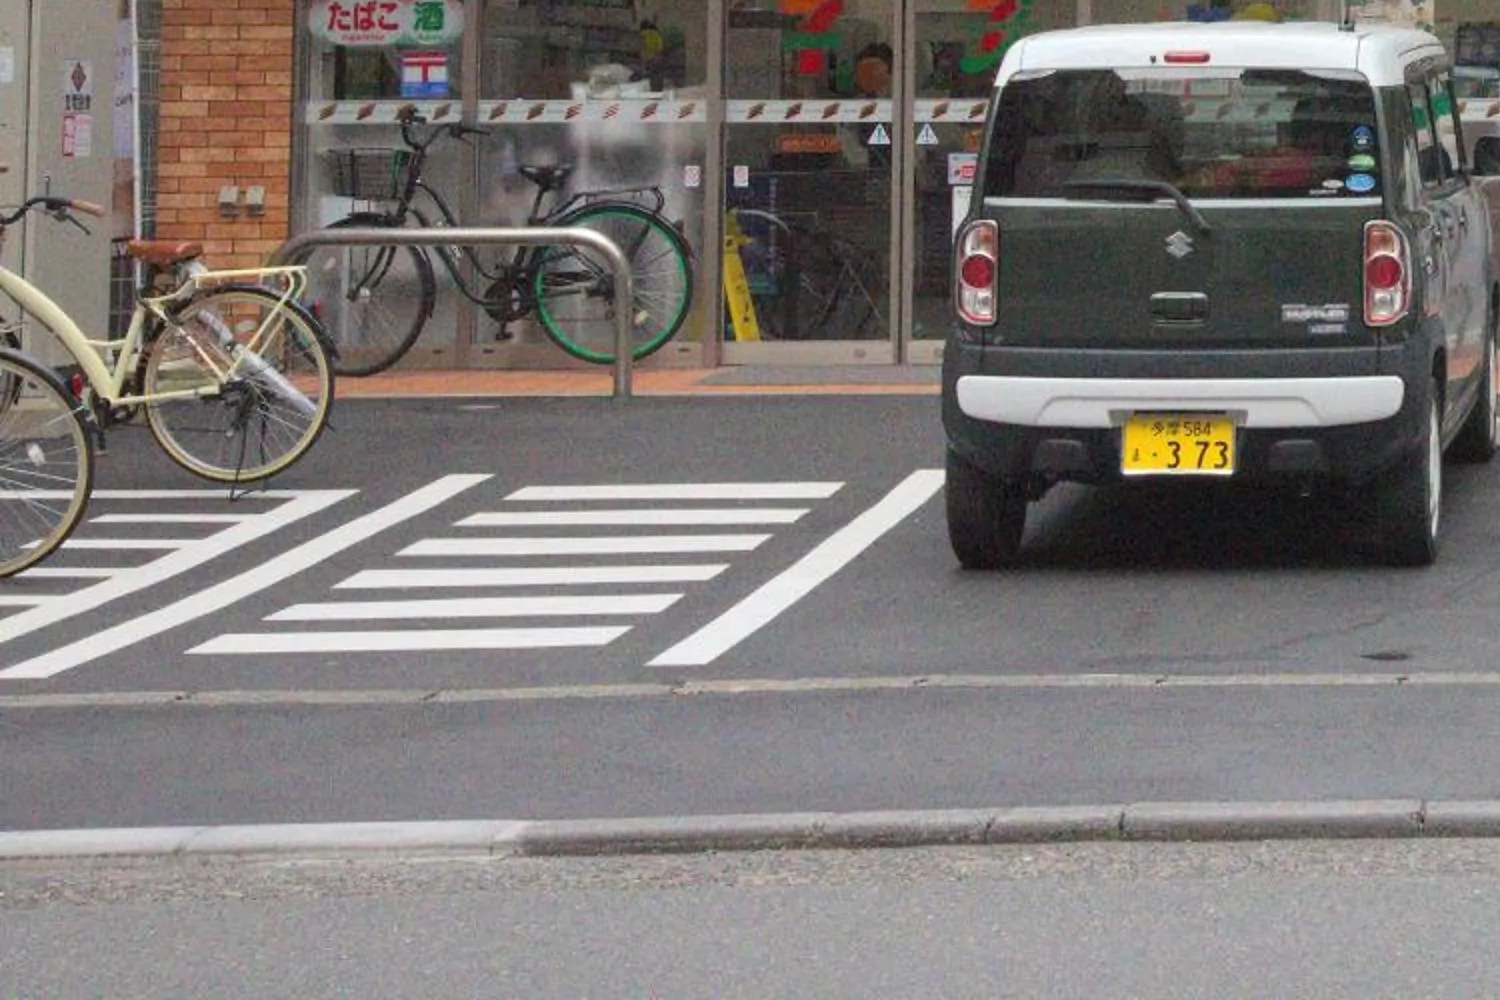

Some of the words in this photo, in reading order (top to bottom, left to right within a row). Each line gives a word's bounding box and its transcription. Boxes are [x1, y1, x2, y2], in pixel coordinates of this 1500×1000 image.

[327, 1, 399, 32] たばこ
[413, 1, 445, 32] 酒
[1182, 420, 1211, 437] 584
